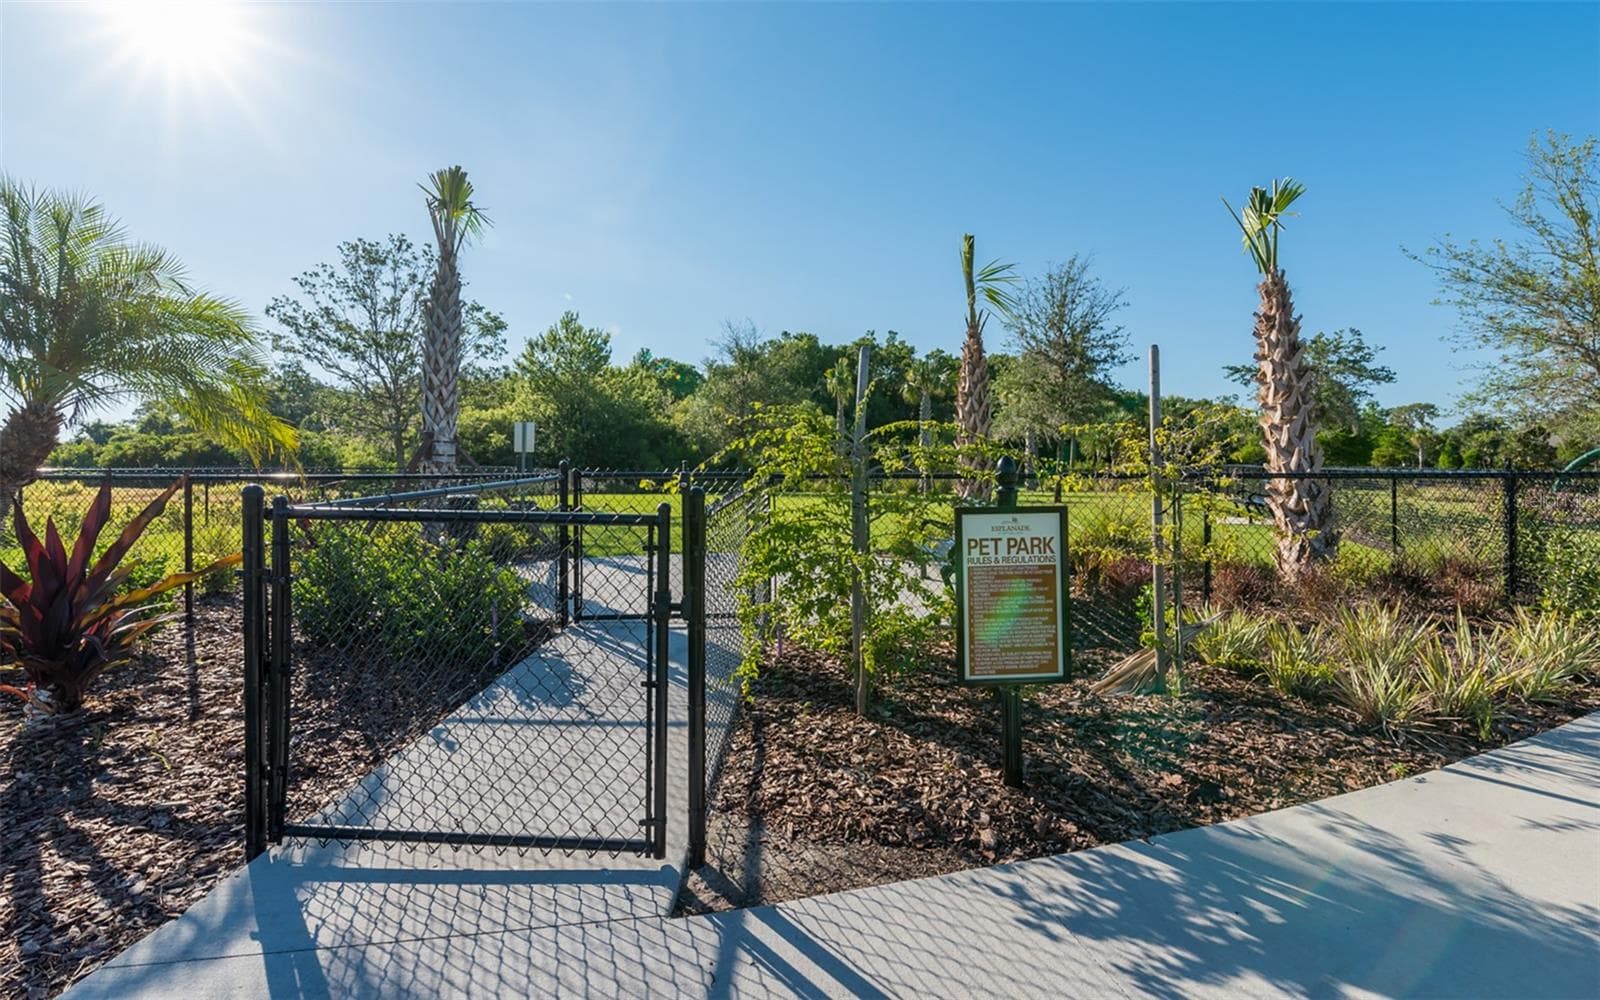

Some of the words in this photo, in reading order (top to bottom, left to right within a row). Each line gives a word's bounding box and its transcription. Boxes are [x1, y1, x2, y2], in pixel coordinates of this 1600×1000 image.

[967, 537, 1003, 556] PET
[1007, 536, 1056, 555] PARK
[967, 556, 992, 565] RULES
[994, 556, 1001, 564] &
[1002, 555, 1057, 564] REGULATIONS
